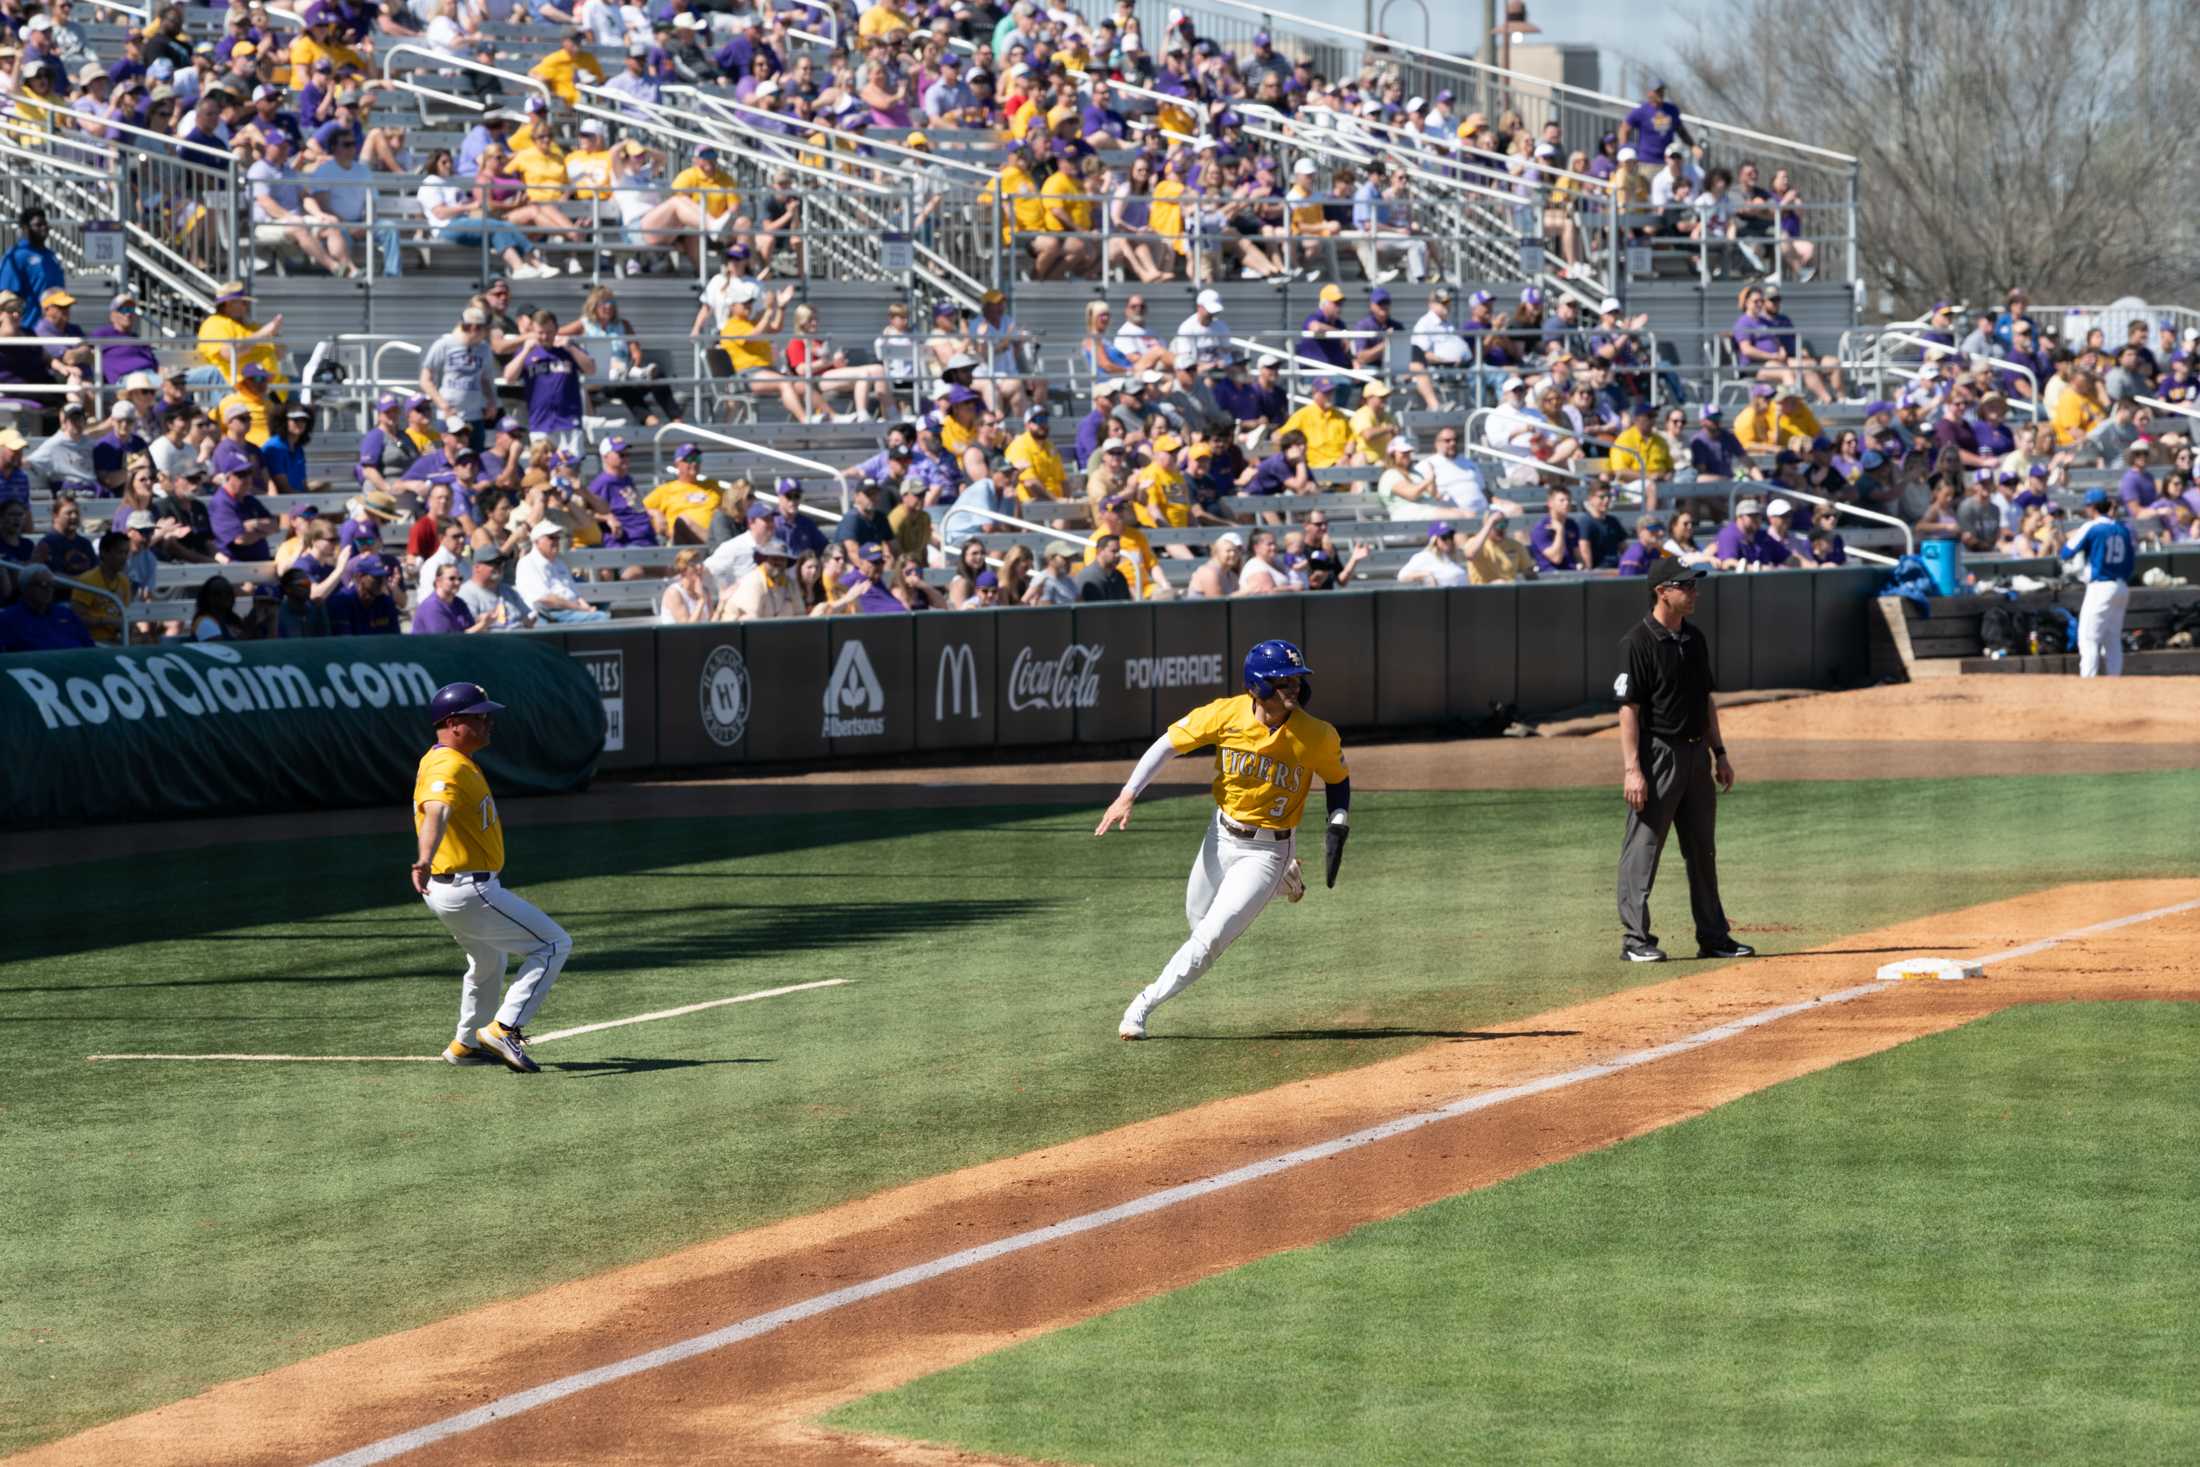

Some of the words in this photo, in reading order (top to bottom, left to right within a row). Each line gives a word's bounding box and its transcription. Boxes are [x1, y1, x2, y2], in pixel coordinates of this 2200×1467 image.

[2104, 535, 2126, 565] 19
[1125, 654, 1223, 690] POWERADE
[1613, 672, 1629, 697] 4
[7, 648, 439, 730] RoofClaim.com
[821, 716, 886, 737] Albertsons
[1221, 747, 1305, 793] TIGERS
[1268, 795, 1289, 818] 3
